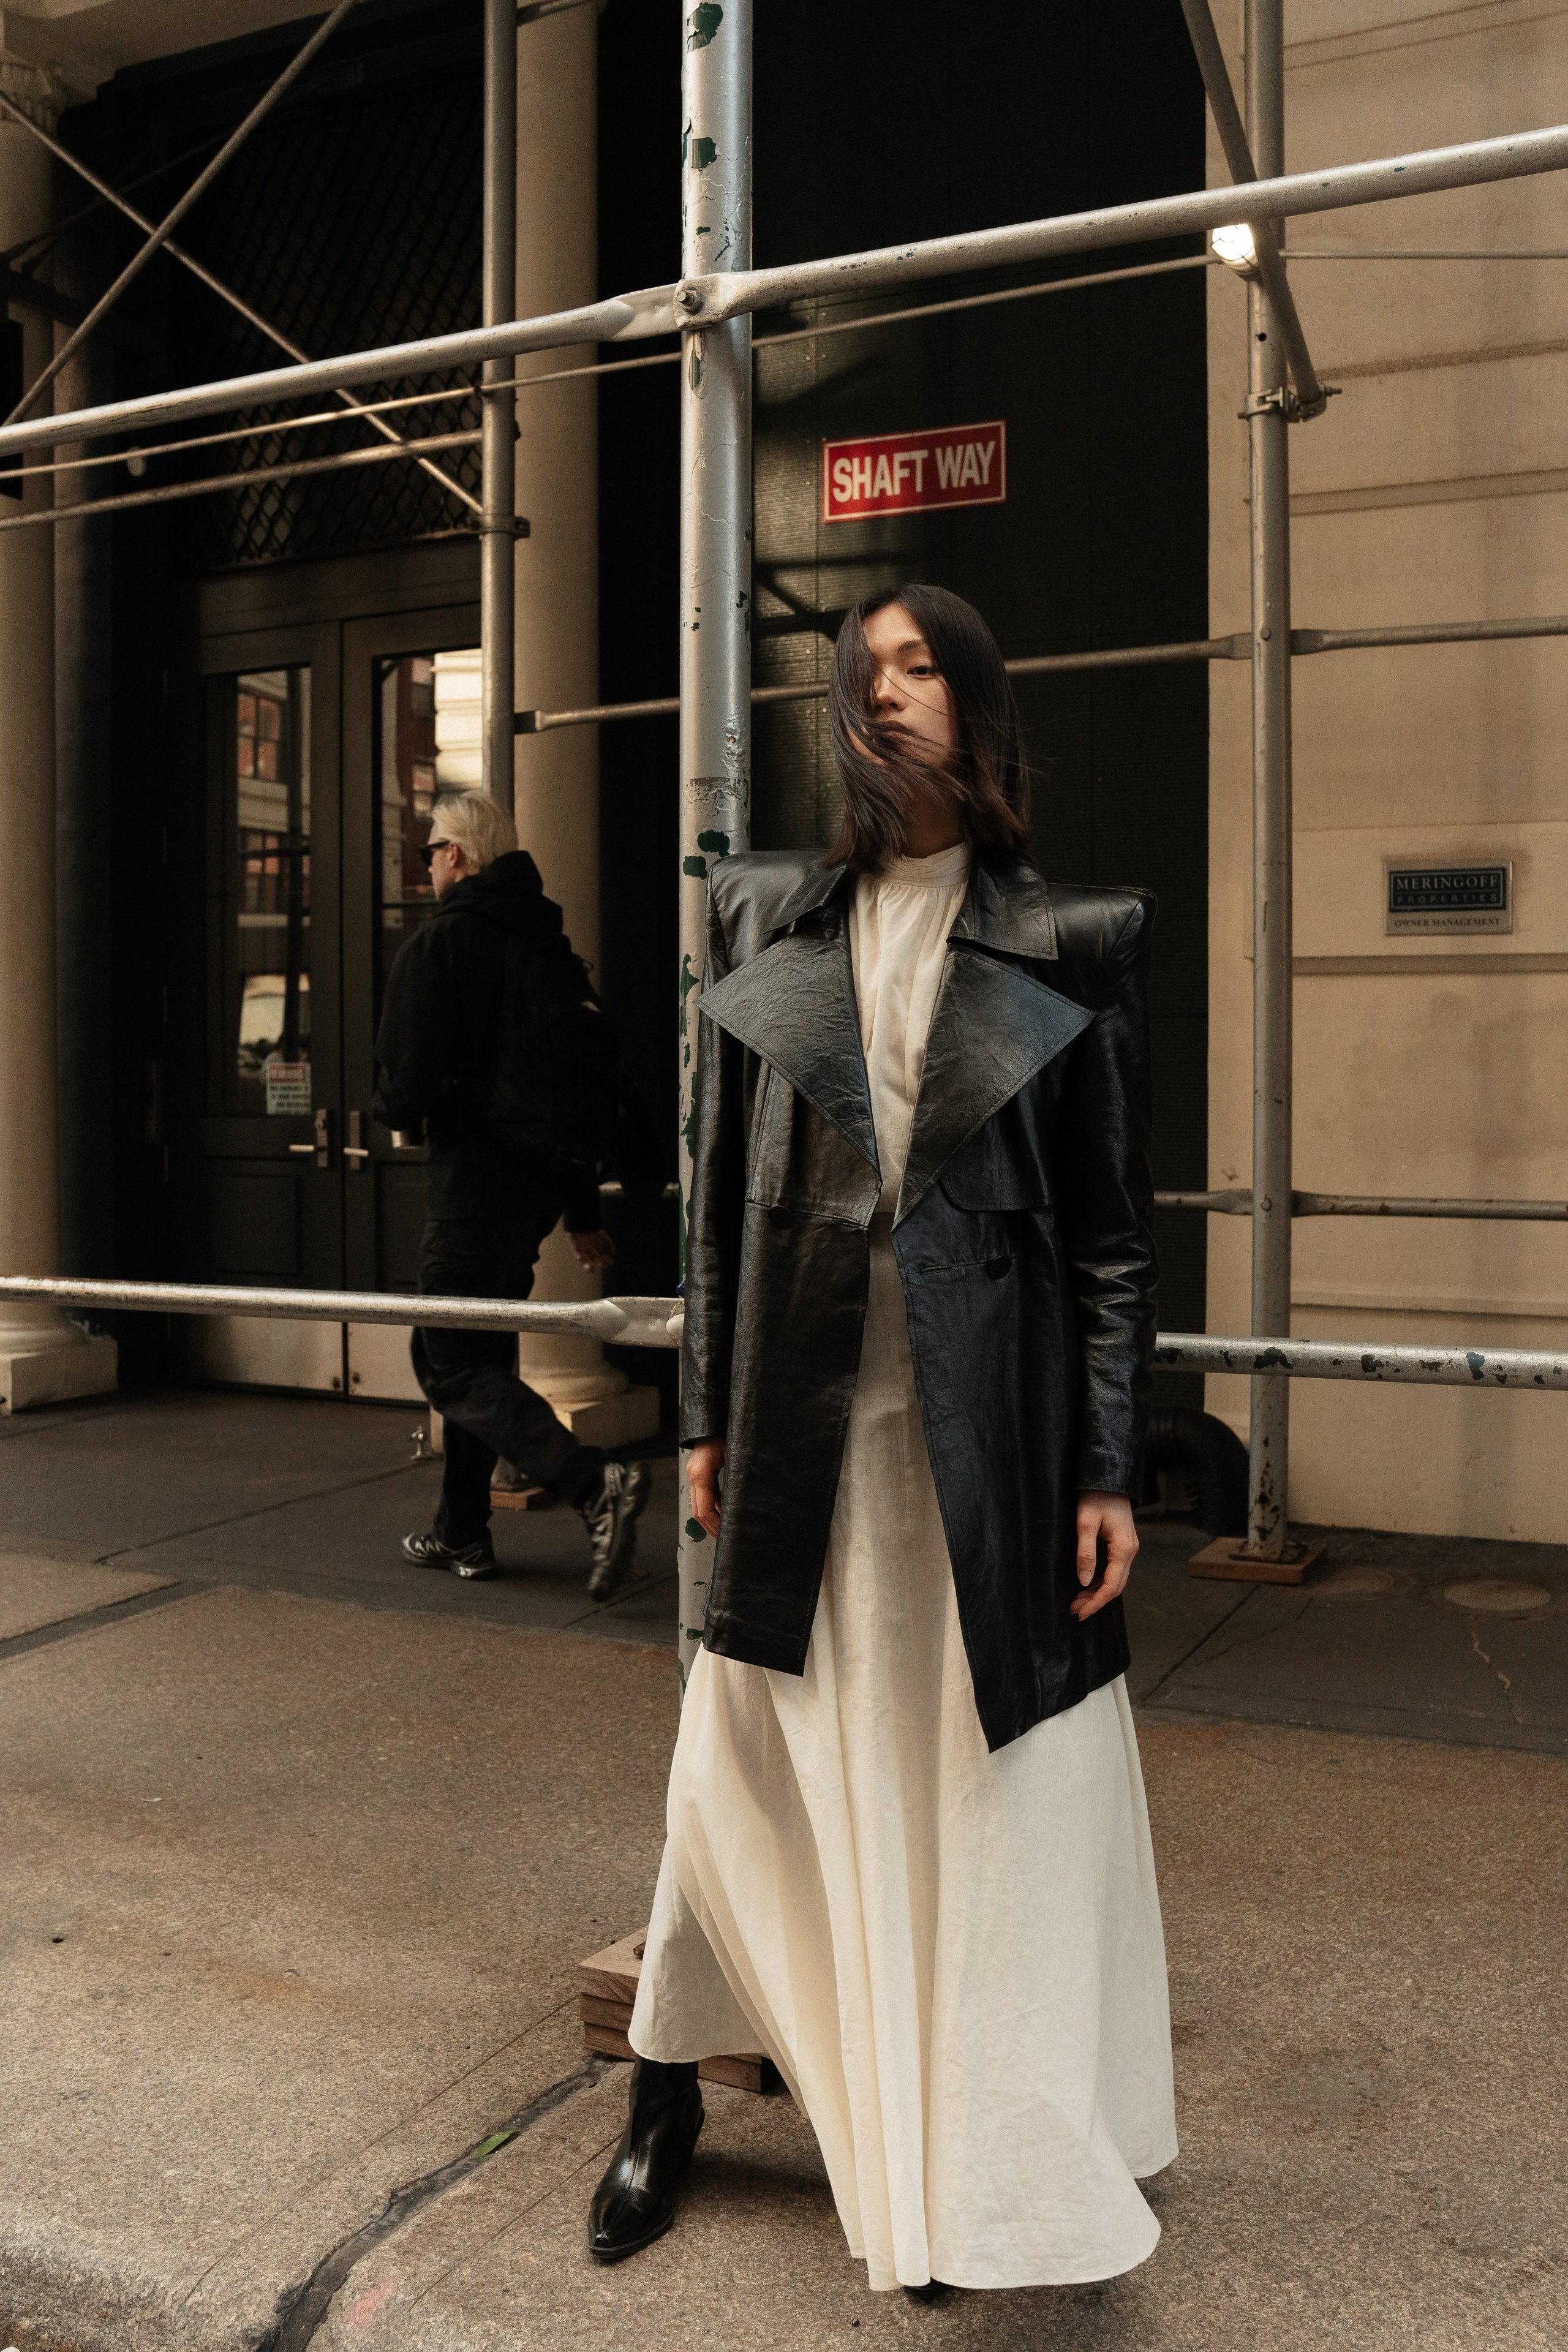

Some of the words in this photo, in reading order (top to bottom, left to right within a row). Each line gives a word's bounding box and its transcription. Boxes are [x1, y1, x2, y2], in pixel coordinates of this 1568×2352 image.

[833, 450, 928, 502] SHAFT
[935, 441, 996, 489] WAY
[1396, 876, 1497, 890] MERINGOFF
[1397, 894, 1496, 903] PROPERTIES
